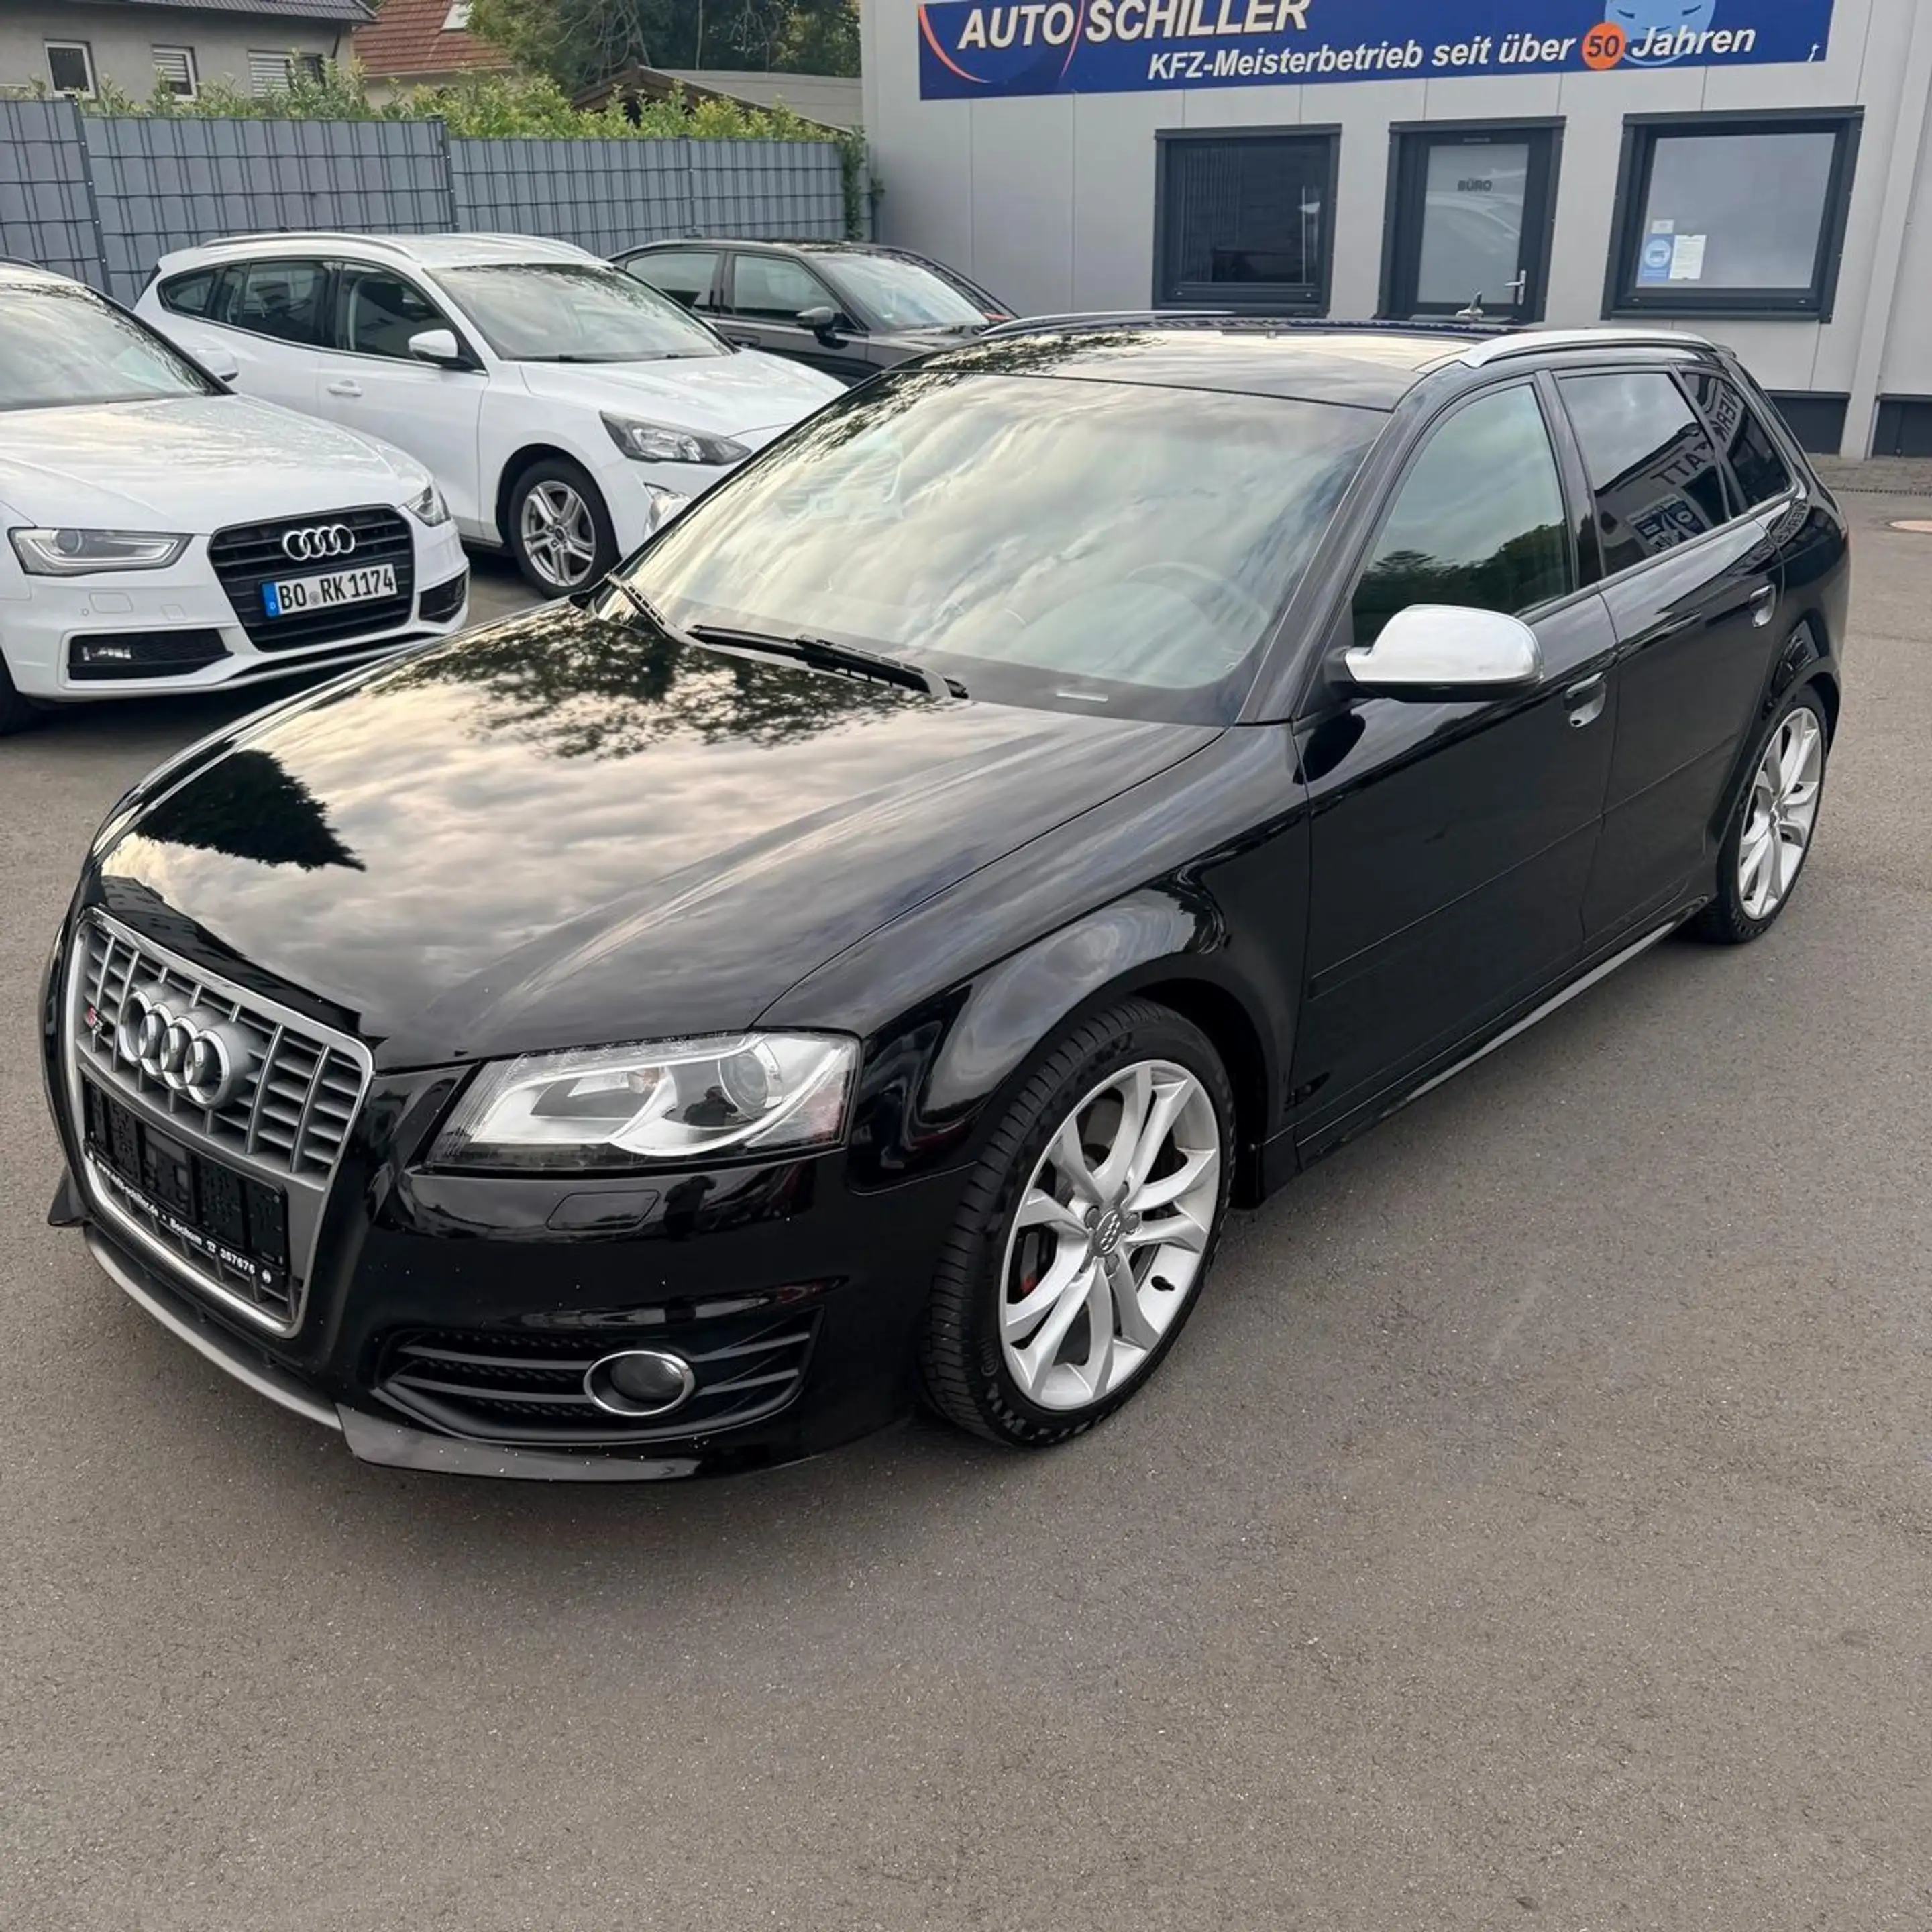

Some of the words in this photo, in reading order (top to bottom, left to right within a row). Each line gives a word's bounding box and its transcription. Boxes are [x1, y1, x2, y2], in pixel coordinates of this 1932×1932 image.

[957, 3, 1075, 50] AUTO
[1085, 0, 1309, 42] SCHILLER
[1148, 40, 1424, 80] KFZ-Meisterbetrieb
[1431, 36, 1492, 67] seit
[1499, 33, 1576, 64] über
[1587, 35, 1619, 58] 50
[1631, 25, 1756, 58] Jahren
[1457, 178, 1493, 192] BÜRO
[278, 583, 307, 610] BO
[319, 575, 347, 603] RK
[348, 568, 394, 598] 1174
